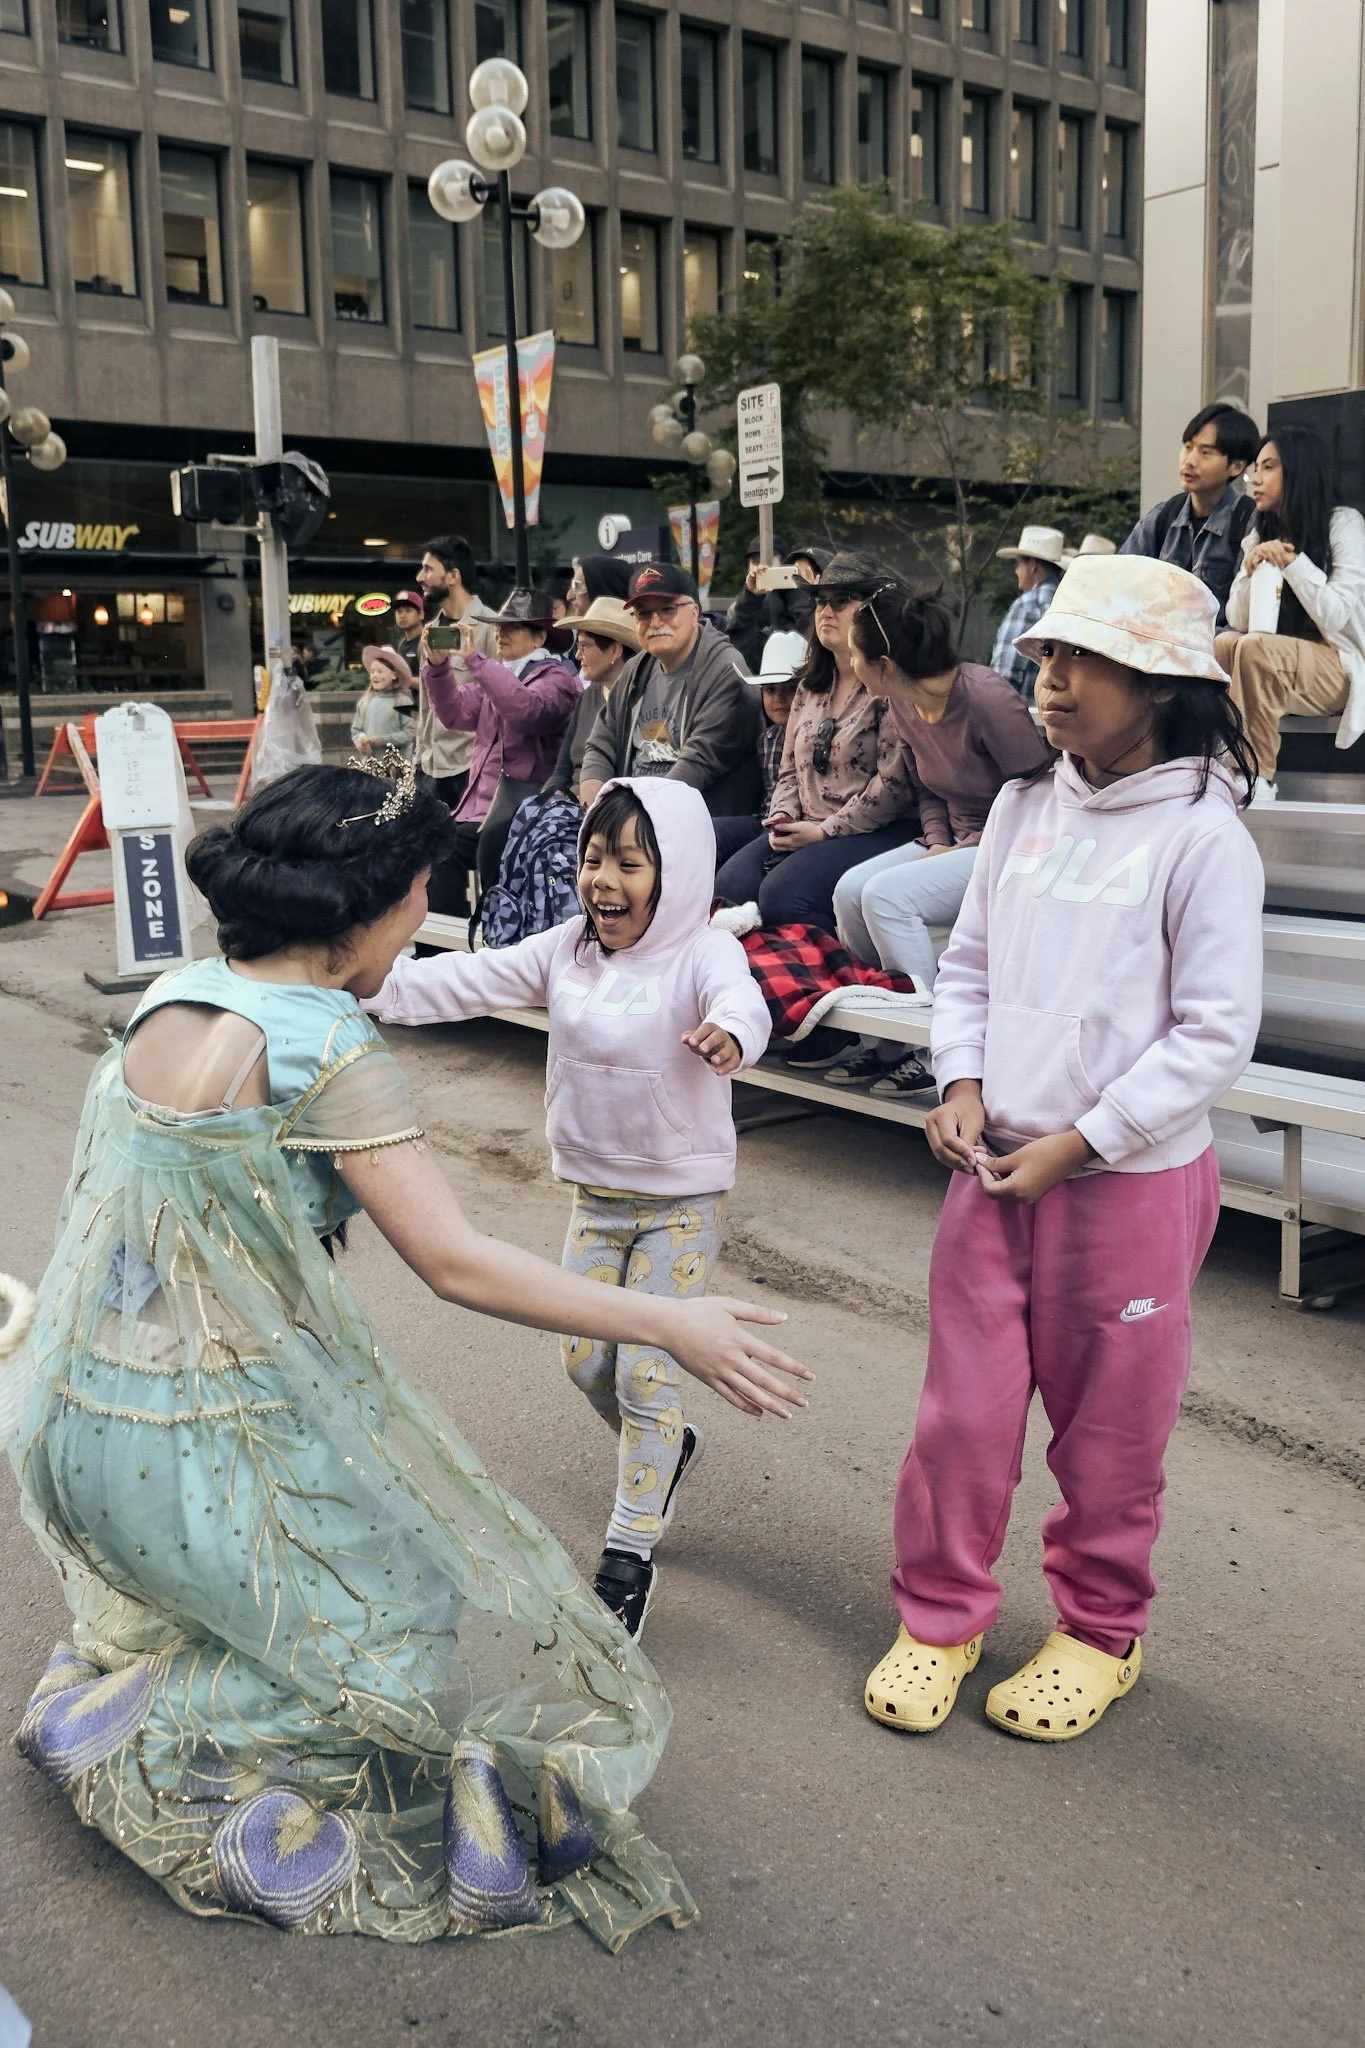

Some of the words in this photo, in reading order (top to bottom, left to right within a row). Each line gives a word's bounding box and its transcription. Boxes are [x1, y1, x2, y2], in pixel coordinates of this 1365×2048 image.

[740, 394, 764, 411] SITE
[744, 415, 763, 425] BLOCK
[744, 430, 761, 439] ROWS
[745, 444, 763, 453] SEATS
[17, 521, 140, 551] SUBWAY
[637, 551, 653, 563] Core
[288, 594, 355, 616] UBWAY
[996, 835, 1150, 908] FILA
[141, 858, 166, 939] ZONE
[1126, 1297, 1156, 1313] NIKE
